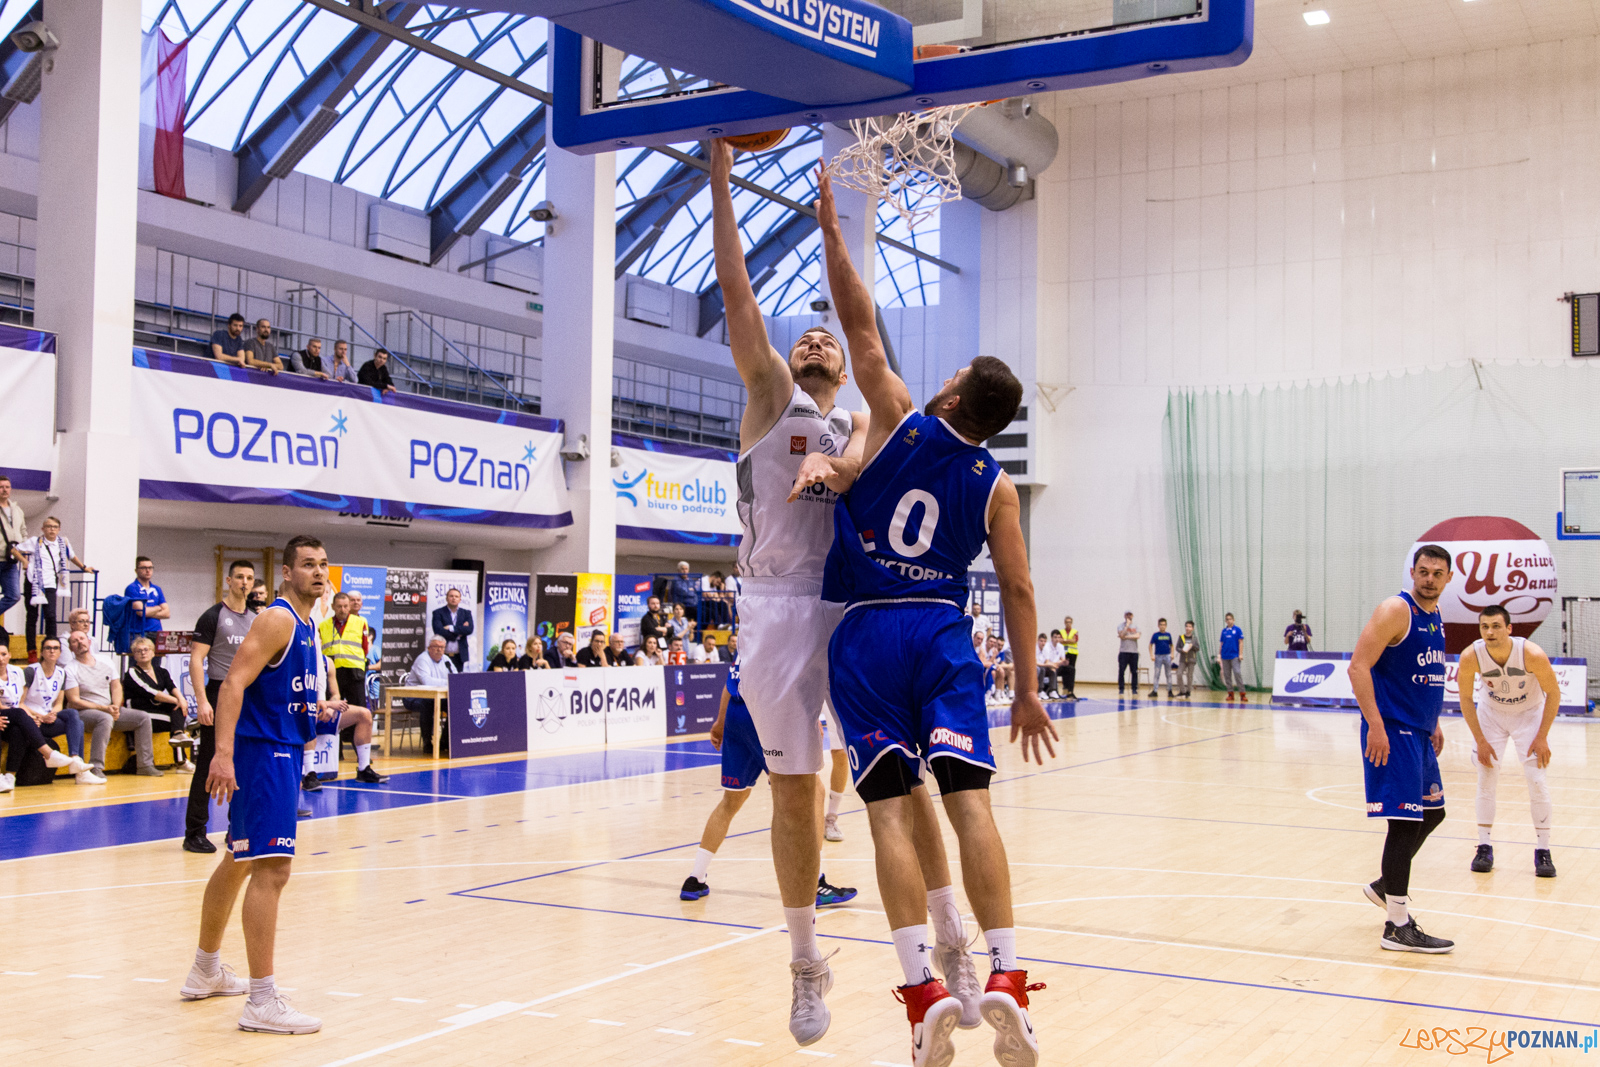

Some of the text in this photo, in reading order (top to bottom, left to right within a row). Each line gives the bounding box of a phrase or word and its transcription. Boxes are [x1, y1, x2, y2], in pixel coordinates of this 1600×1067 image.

[646, 473, 726, 505] funclub
[648, 500, 677, 511] biuro
[888, 489, 940, 557] 0
[1456, 551, 1500, 596] U
[488, 586, 527, 606] SELENKA
[618, 595, 641, 605] MOCNE
[52, 680, 58, 691] 9
[1292, 671, 1325, 683] atrem
[570, 687, 656, 714] BIOFARM
